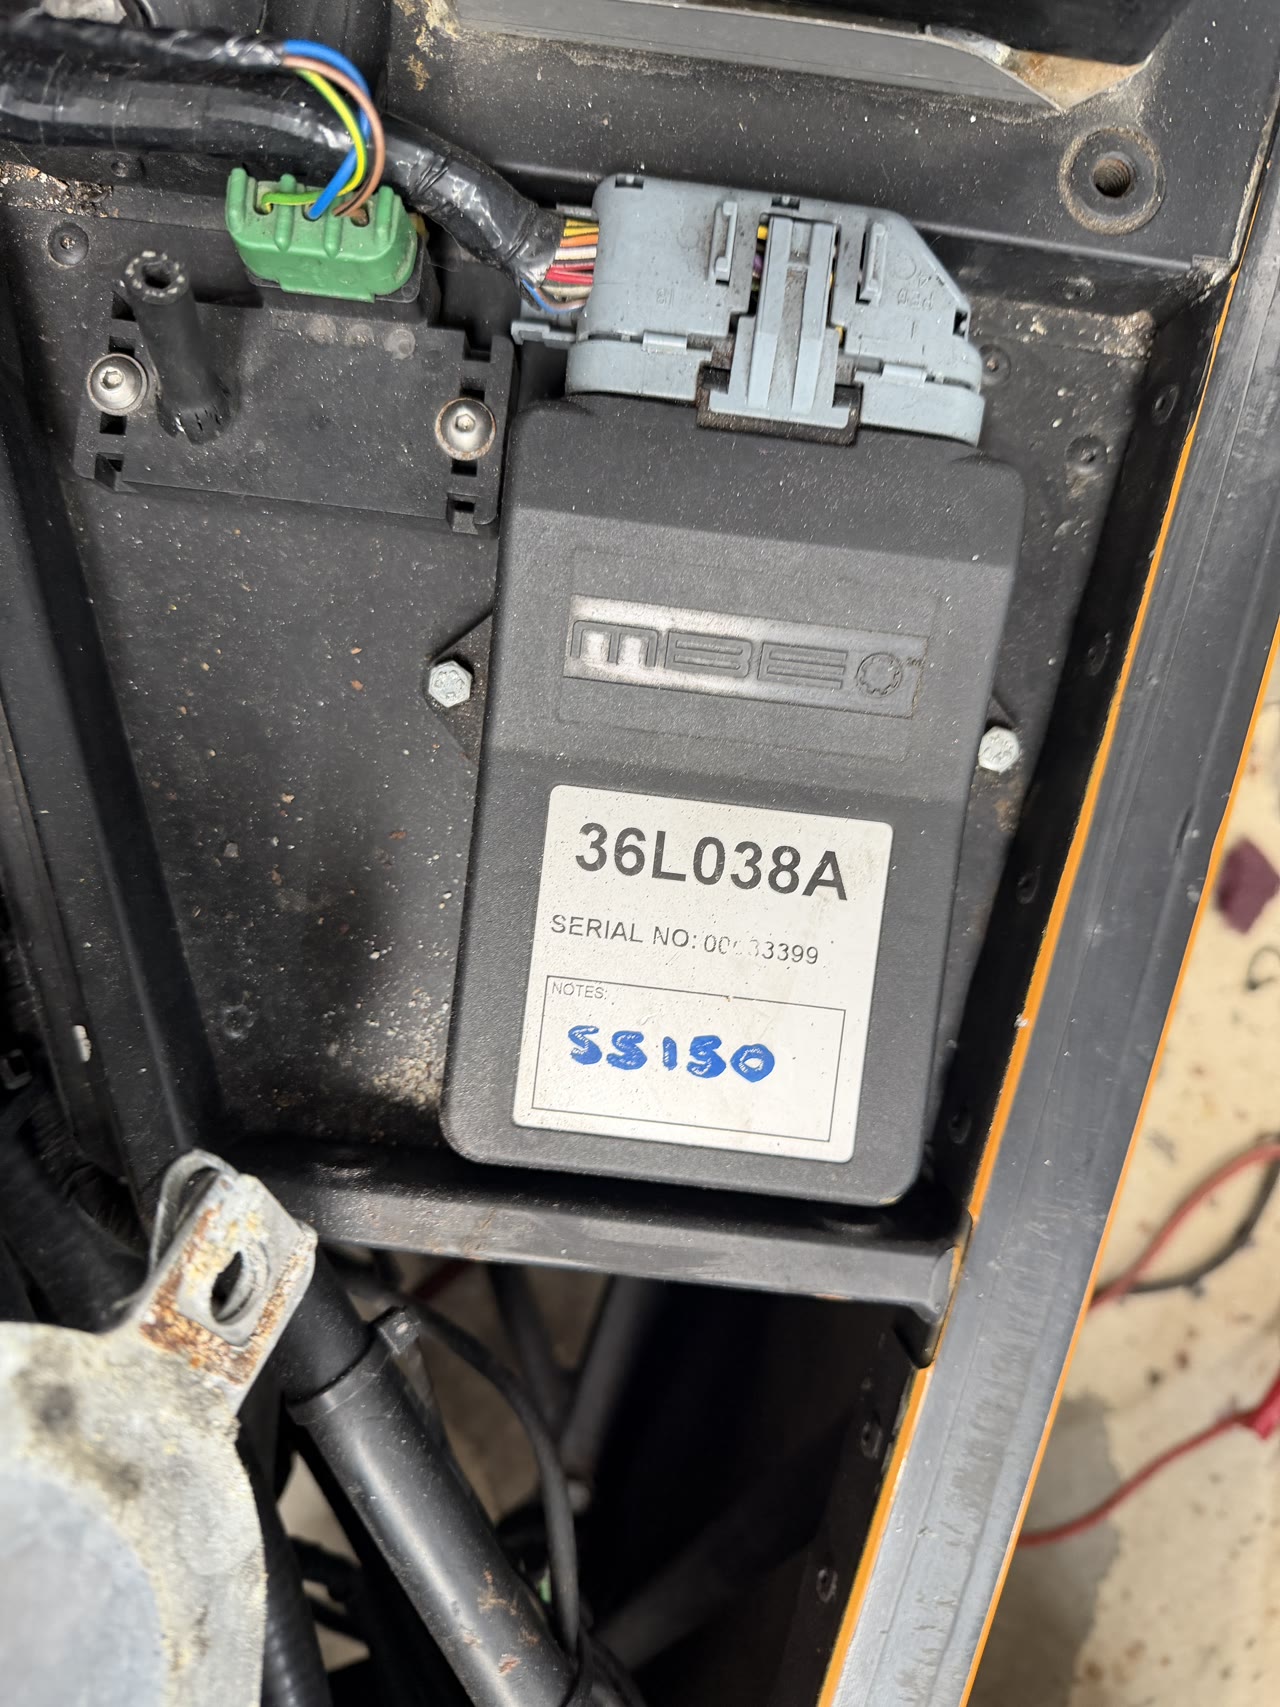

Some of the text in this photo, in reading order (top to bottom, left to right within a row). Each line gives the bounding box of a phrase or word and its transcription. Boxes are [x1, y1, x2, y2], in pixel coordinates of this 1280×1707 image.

[575, 822, 848, 901] 36L038A
[551, 914, 643, 943] SERIAL
[653, 926, 697, 950] NO:
[551, 981, 608, 1000] NOTES:
[567, 1024, 776, 1083] SS150
